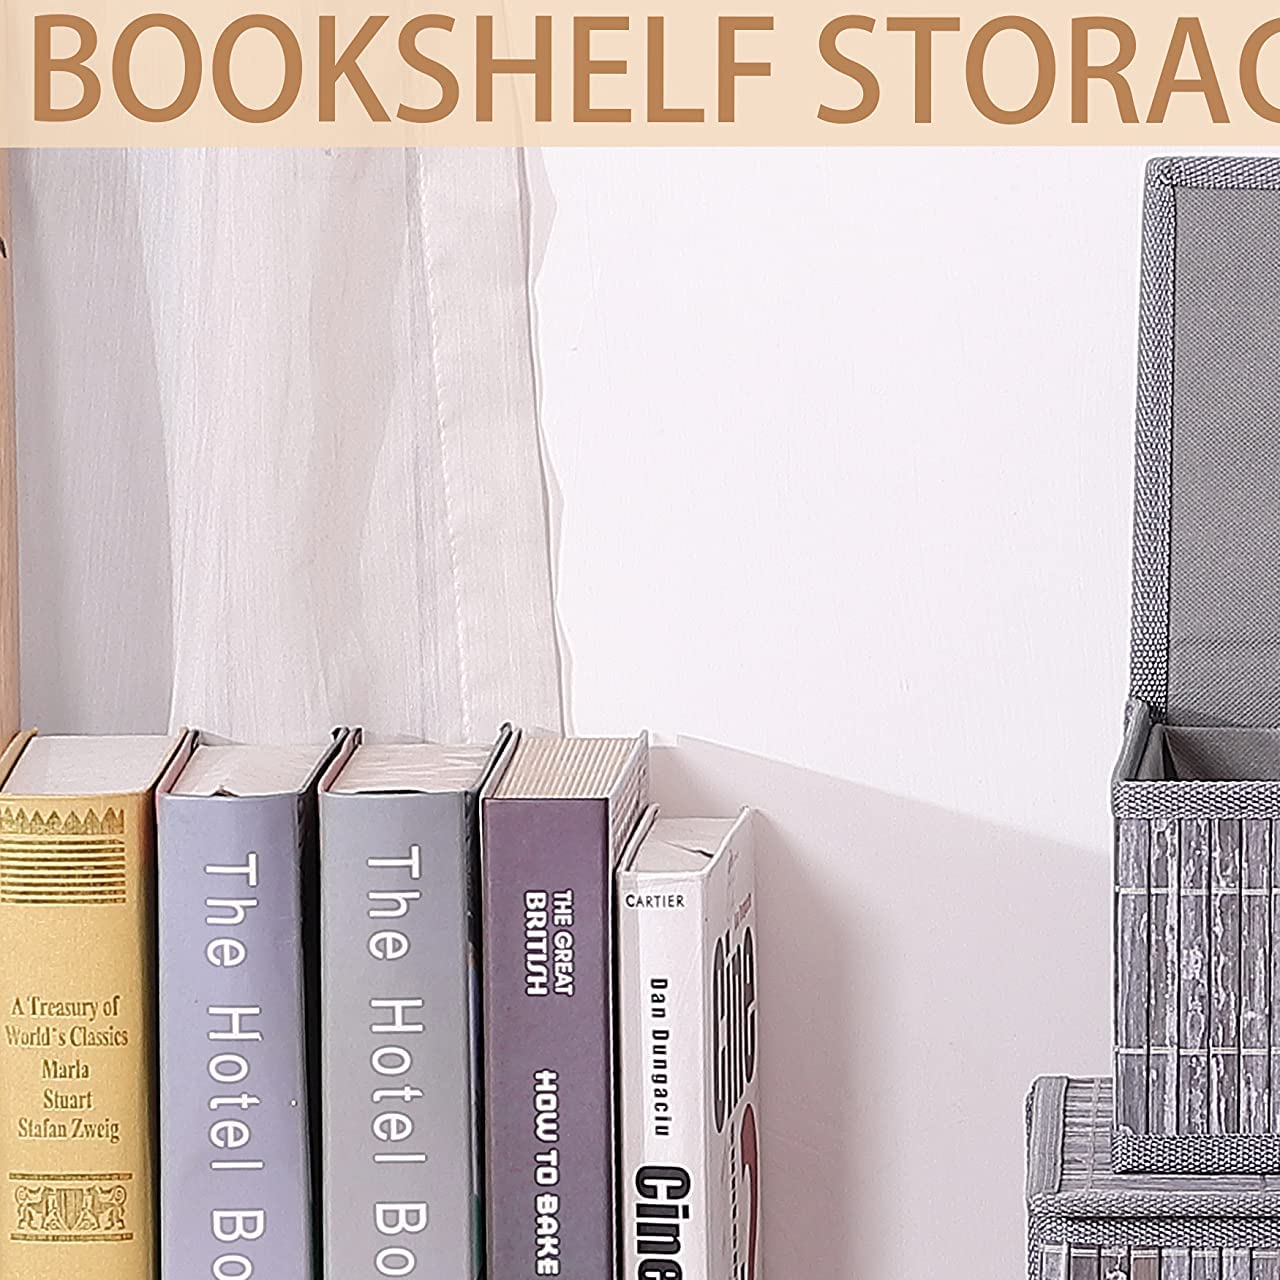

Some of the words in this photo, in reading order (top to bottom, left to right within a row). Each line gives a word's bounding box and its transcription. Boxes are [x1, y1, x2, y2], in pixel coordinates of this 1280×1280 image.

[204, 852, 258, 967] The
[367, 844, 421, 960] The
[553, 889, 573, 926] THE
[625, 894, 685, 908] CARTIER
[524, 889, 549, 997] BRITISH
[553, 929, 574, 997] GREAT
[11, 997, 24, 1016] A
[27, 996, 98, 1022] Treasury
[103, 995, 120, 1016] of
[651, 978, 668, 1018] Dan
[70, 1025, 128, 1046] Classics
[43, 1088, 93, 1109] Stuart
[207, 1005, 264, 1170] Hotel
[370, 998, 427, 1163] Hotel
[533, 1068, 559, 1143] HOW
[71, 1117, 120, 1144] Zweig
[534, 1148, 560, 1187] TO
[534, 1192, 560, 1277] BAKE
